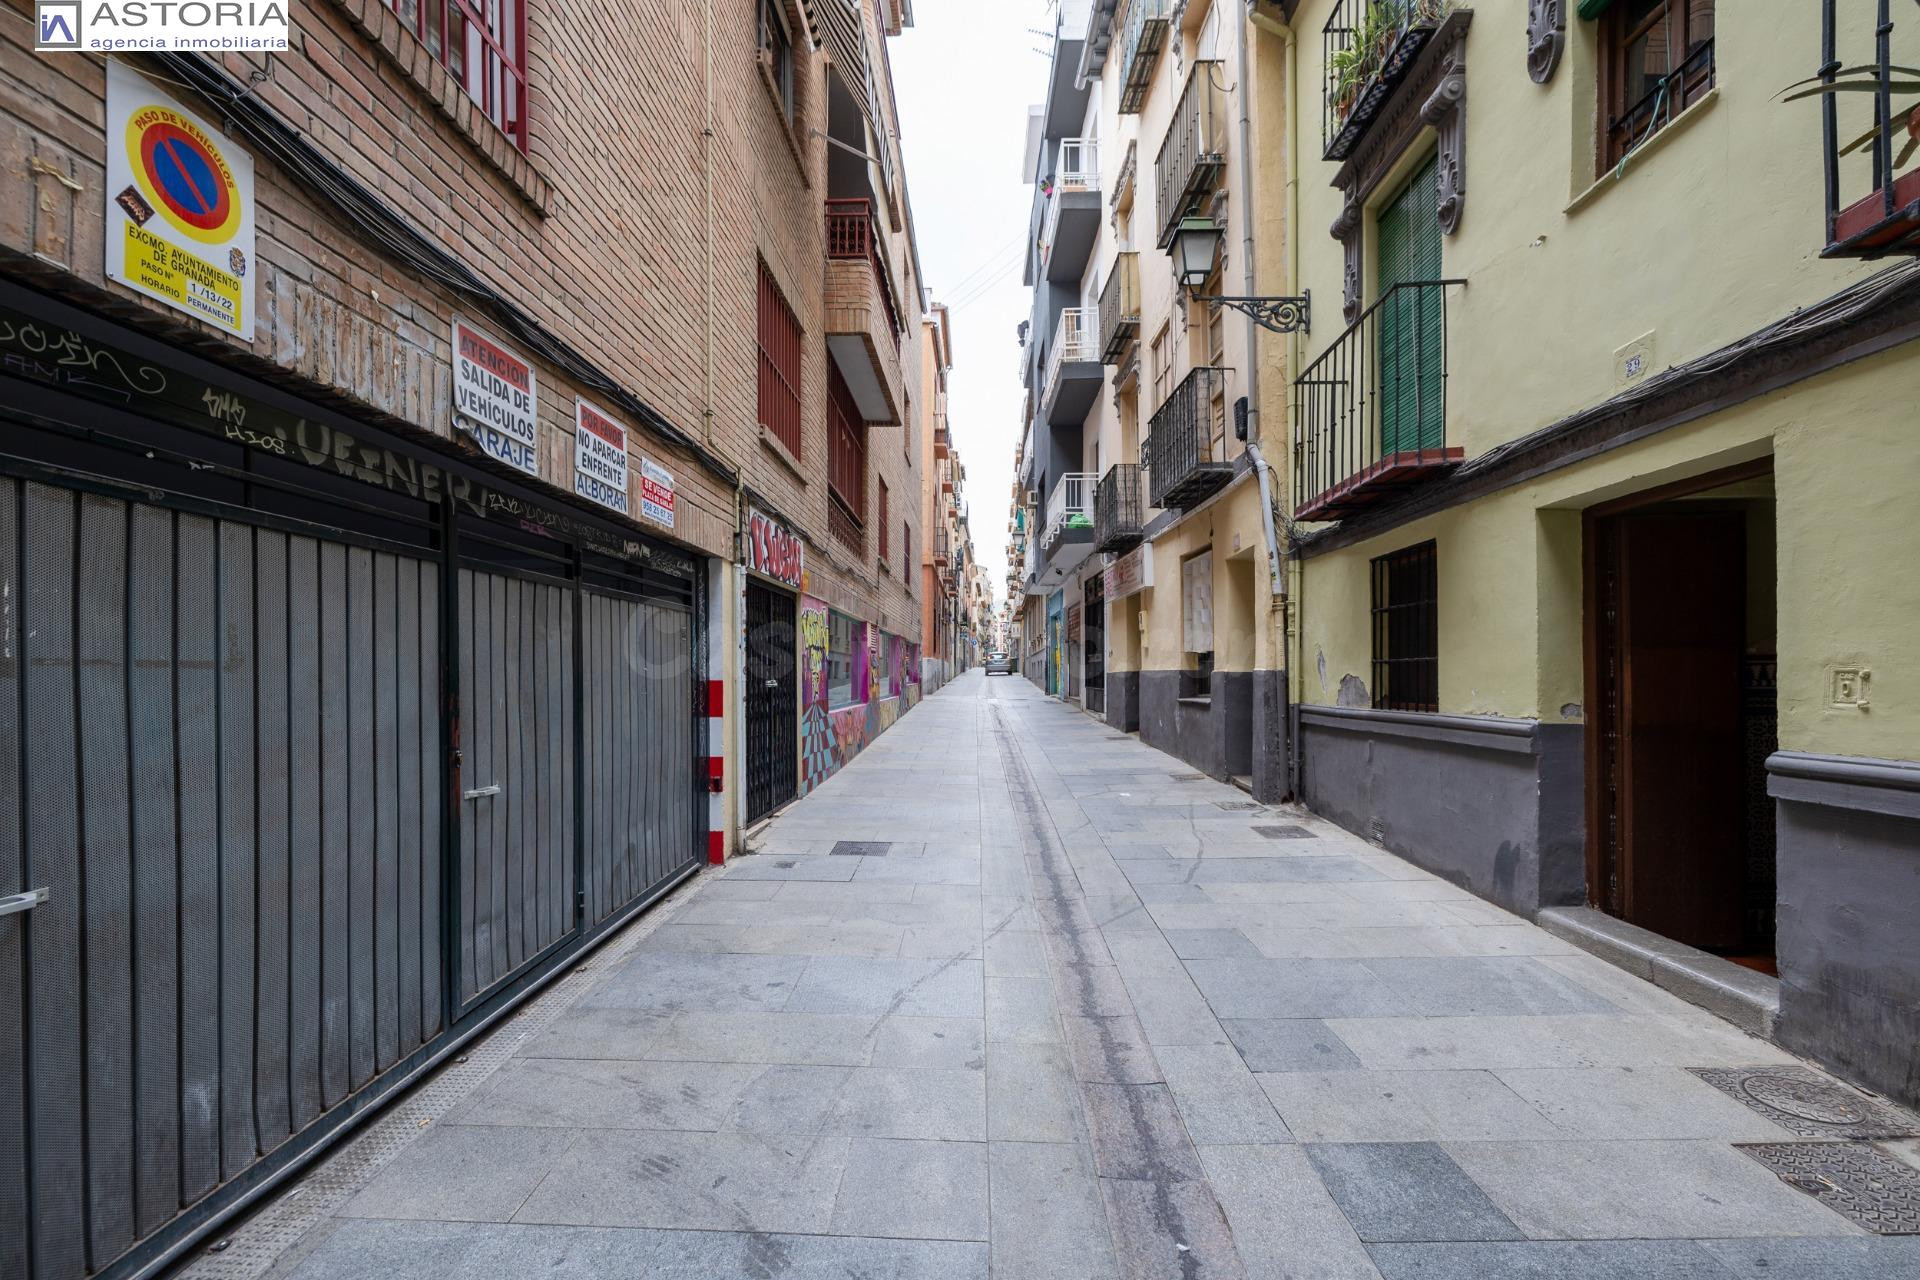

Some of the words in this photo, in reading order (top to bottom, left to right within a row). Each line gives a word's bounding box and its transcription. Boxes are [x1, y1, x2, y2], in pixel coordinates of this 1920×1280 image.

[135, 110, 160, 130] PASO
[161, 111, 178, 124] DE
[128, 225, 168, 255] EXCMO.
[171, 248, 239, 292] AYUNTAMIENTO
[140, 259, 163, 277] PASO
[153, 249, 167, 266] DE
[171, 260, 216, 290] GRANADA
[140, 273, 180, 298] HORARIO
[187, 295, 235, 325] PERMANENTE
[461, 358, 511, 404] SALIDA
[513, 388, 530, 415] DE
[458, 384, 534, 442] VEHÍCULOS
[582, 409, 598, 431] POR
[600, 420, 624, 443] FAVOR
[579, 428, 590, 449] NO
[592, 437, 626, 470] APARCAR
[581, 451, 622, 487] ENFRENTE
[645, 479, 653, 491] SE
